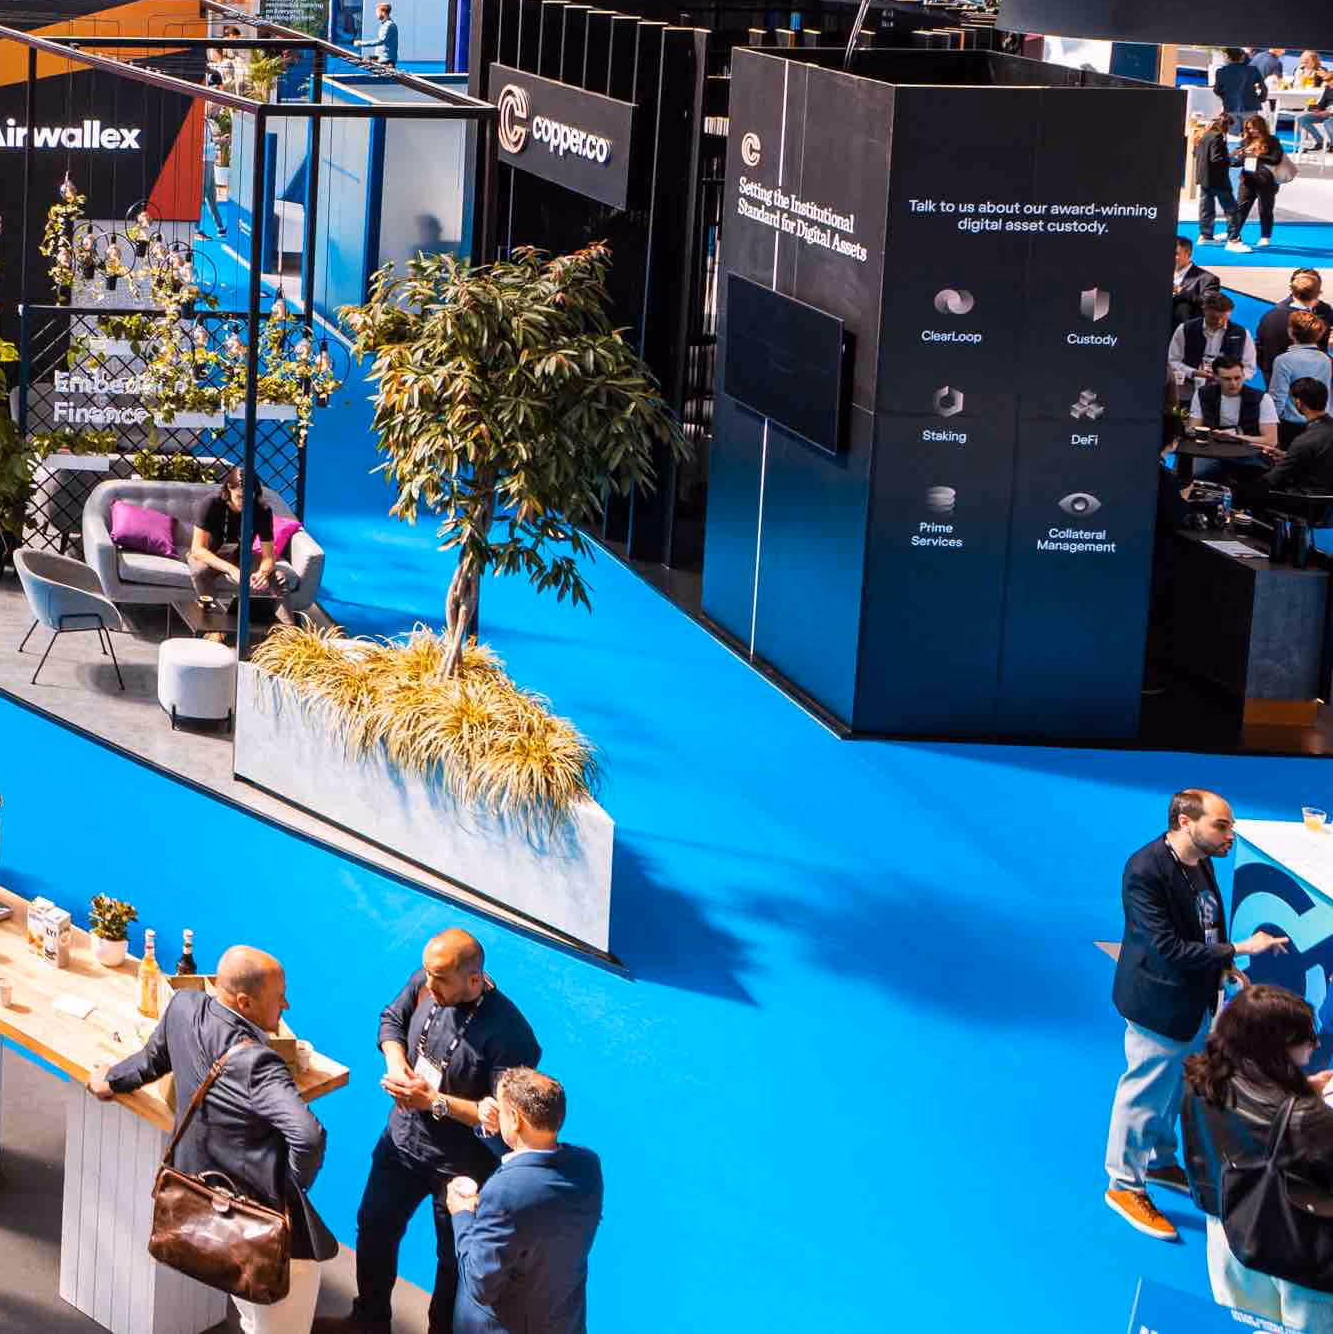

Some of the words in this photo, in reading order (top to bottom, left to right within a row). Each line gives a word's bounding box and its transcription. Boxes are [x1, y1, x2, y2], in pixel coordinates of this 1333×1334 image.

[532, 115, 608, 163] copper.co
[739, 176, 773, 206] Setting
[773, 188, 790, 210] the
[791, 194, 854, 234] Institutional
[909, 199, 935, 213] Talk
[940, 201, 955, 213] to
[959, 203, 974, 213] us
[978, 201, 1020, 214] about
[1023, 204, 1047, 215] our
[1051, 203, 1158, 219] award-winning
[738, 197, 780, 229] Standard
[781, 213, 796, 234] for
[796, 219, 831, 249] Digital
[831, 233, 868, 261] Assets
[958, 217, 1002, 232] digital
[1005, 220, 1044, 232] asset
[1048, 220, 1109, 235] custody.
[921, 330, 982, 344] ClearLoop
[1067, 333, 1118, 347] Custody
[54, 402, 149, 424] Finance
[922, 430, 967, 444] Staking
[1071, 434, 1098, 446] DeFi
[919, 522, 953, 534] Prime
[1048, 528, 1106, 540] Collateral
[911, 535, 963, 548] Services
[1036, 540, 1116, 554] Management
